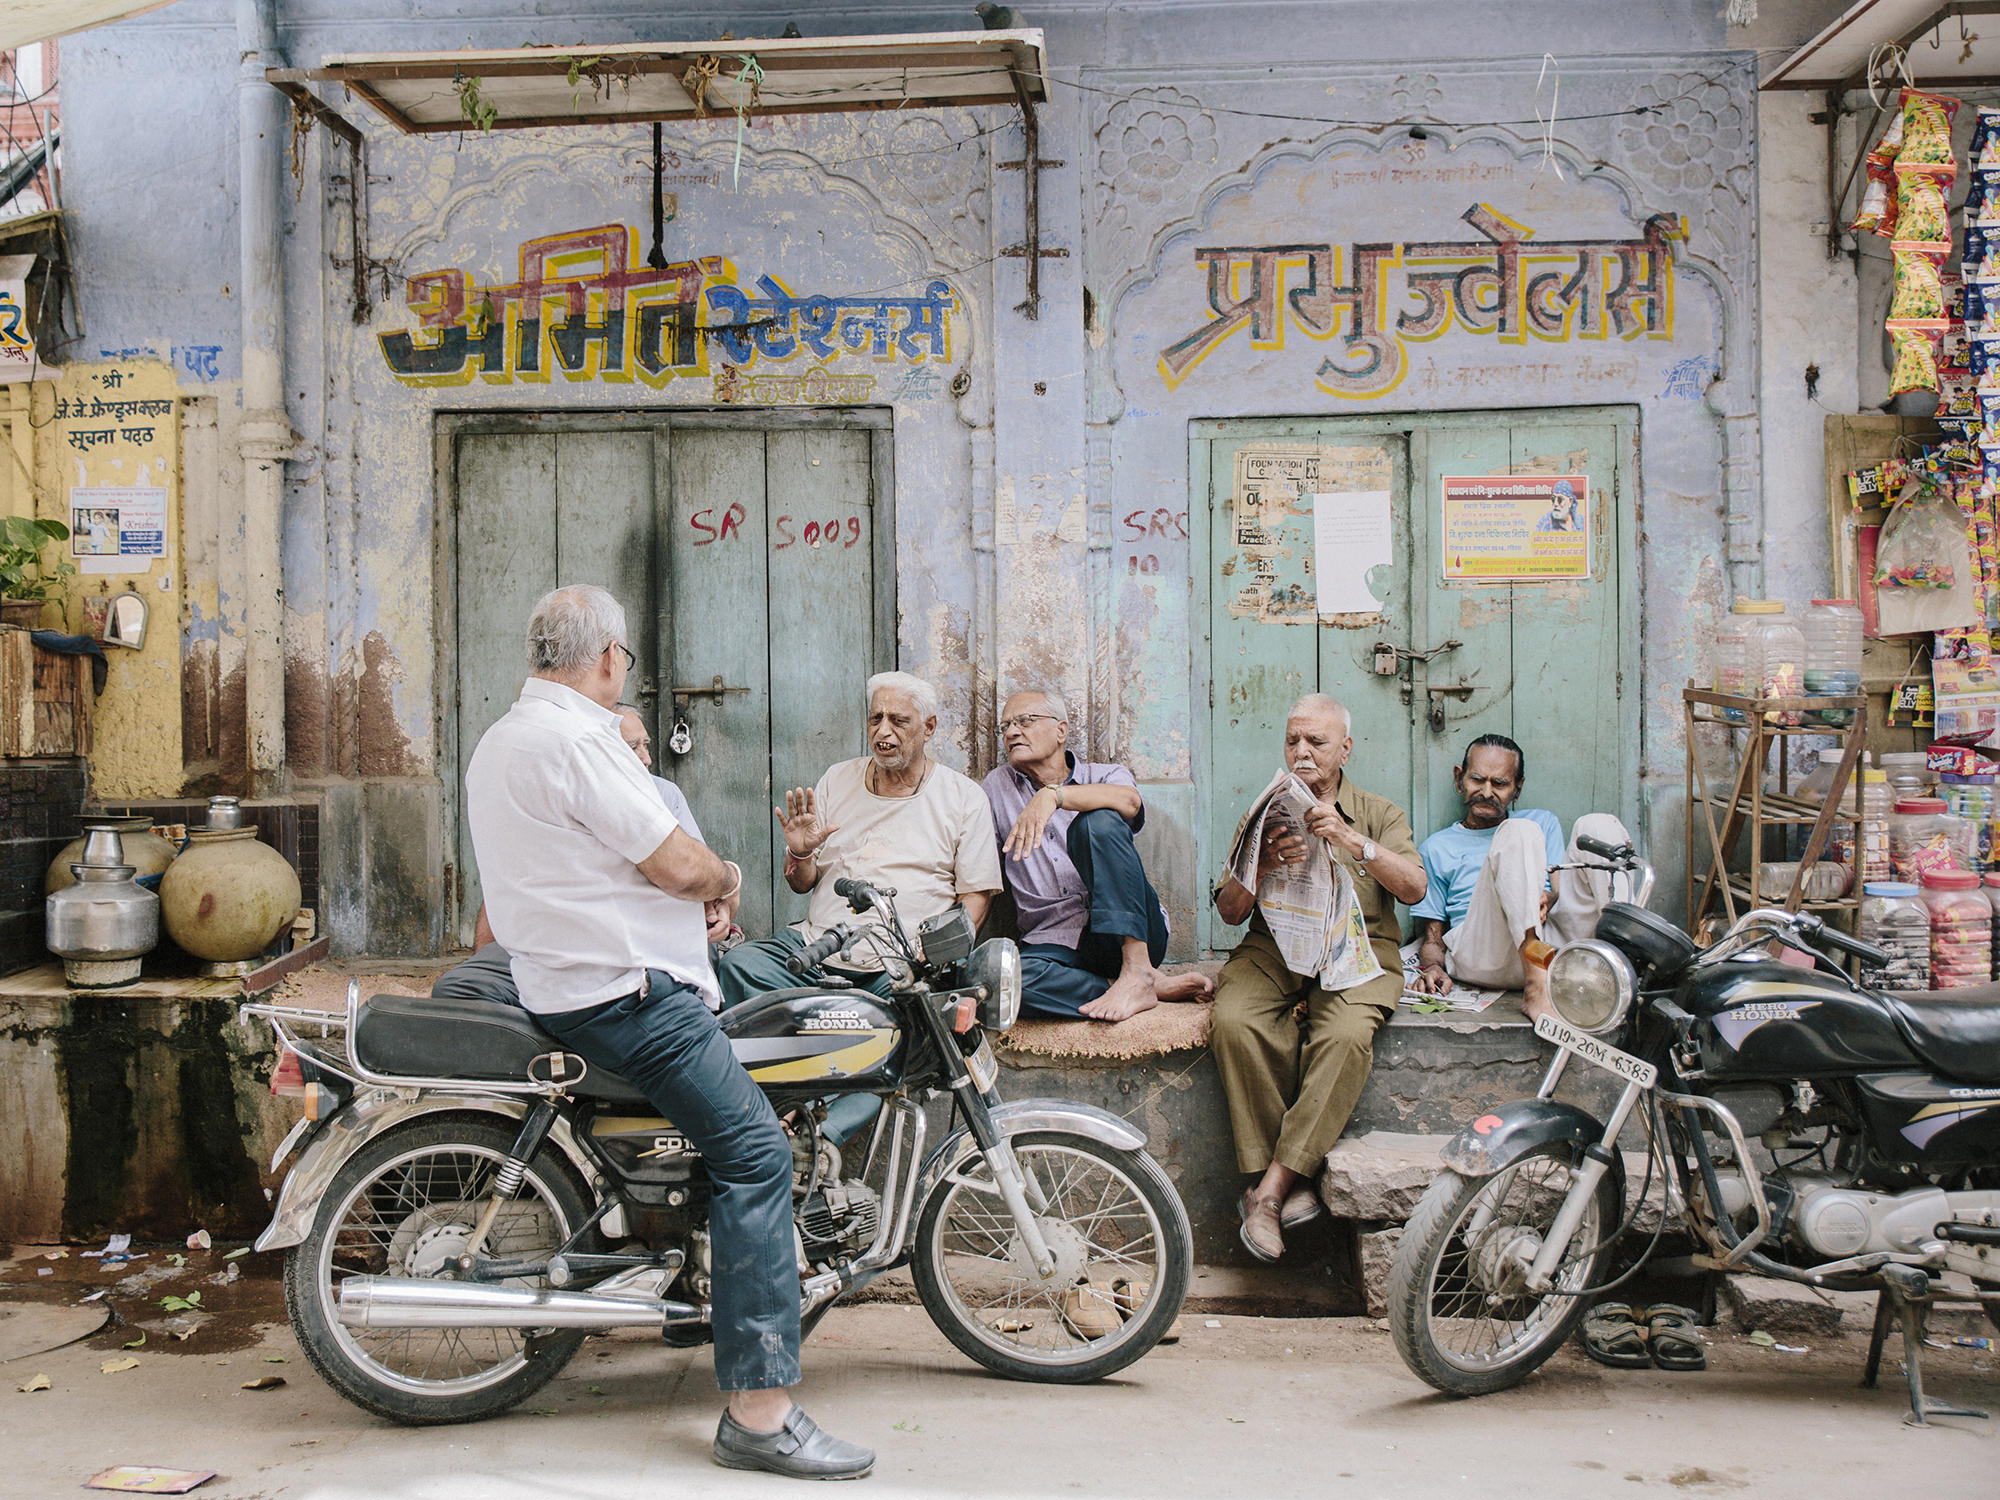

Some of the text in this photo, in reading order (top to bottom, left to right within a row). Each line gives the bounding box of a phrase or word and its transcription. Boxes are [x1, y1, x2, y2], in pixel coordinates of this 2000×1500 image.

[378, 224, 722, 380] अमित
[1159, 205, 1686, 392] प्रभु ज्वेलर्स
[68, 429, 116, 452] सूचना
[690, 502, 746, 547] SR
[819, 1009, 859, 1020] HERO
[1730, 1010, 1800, 1021] HONDA
[1744, 1002, 1787, 1012] HERO
[804, 1018, 873, 1030] HONDA
[1615, 1056, 1650, 1082] 6385
